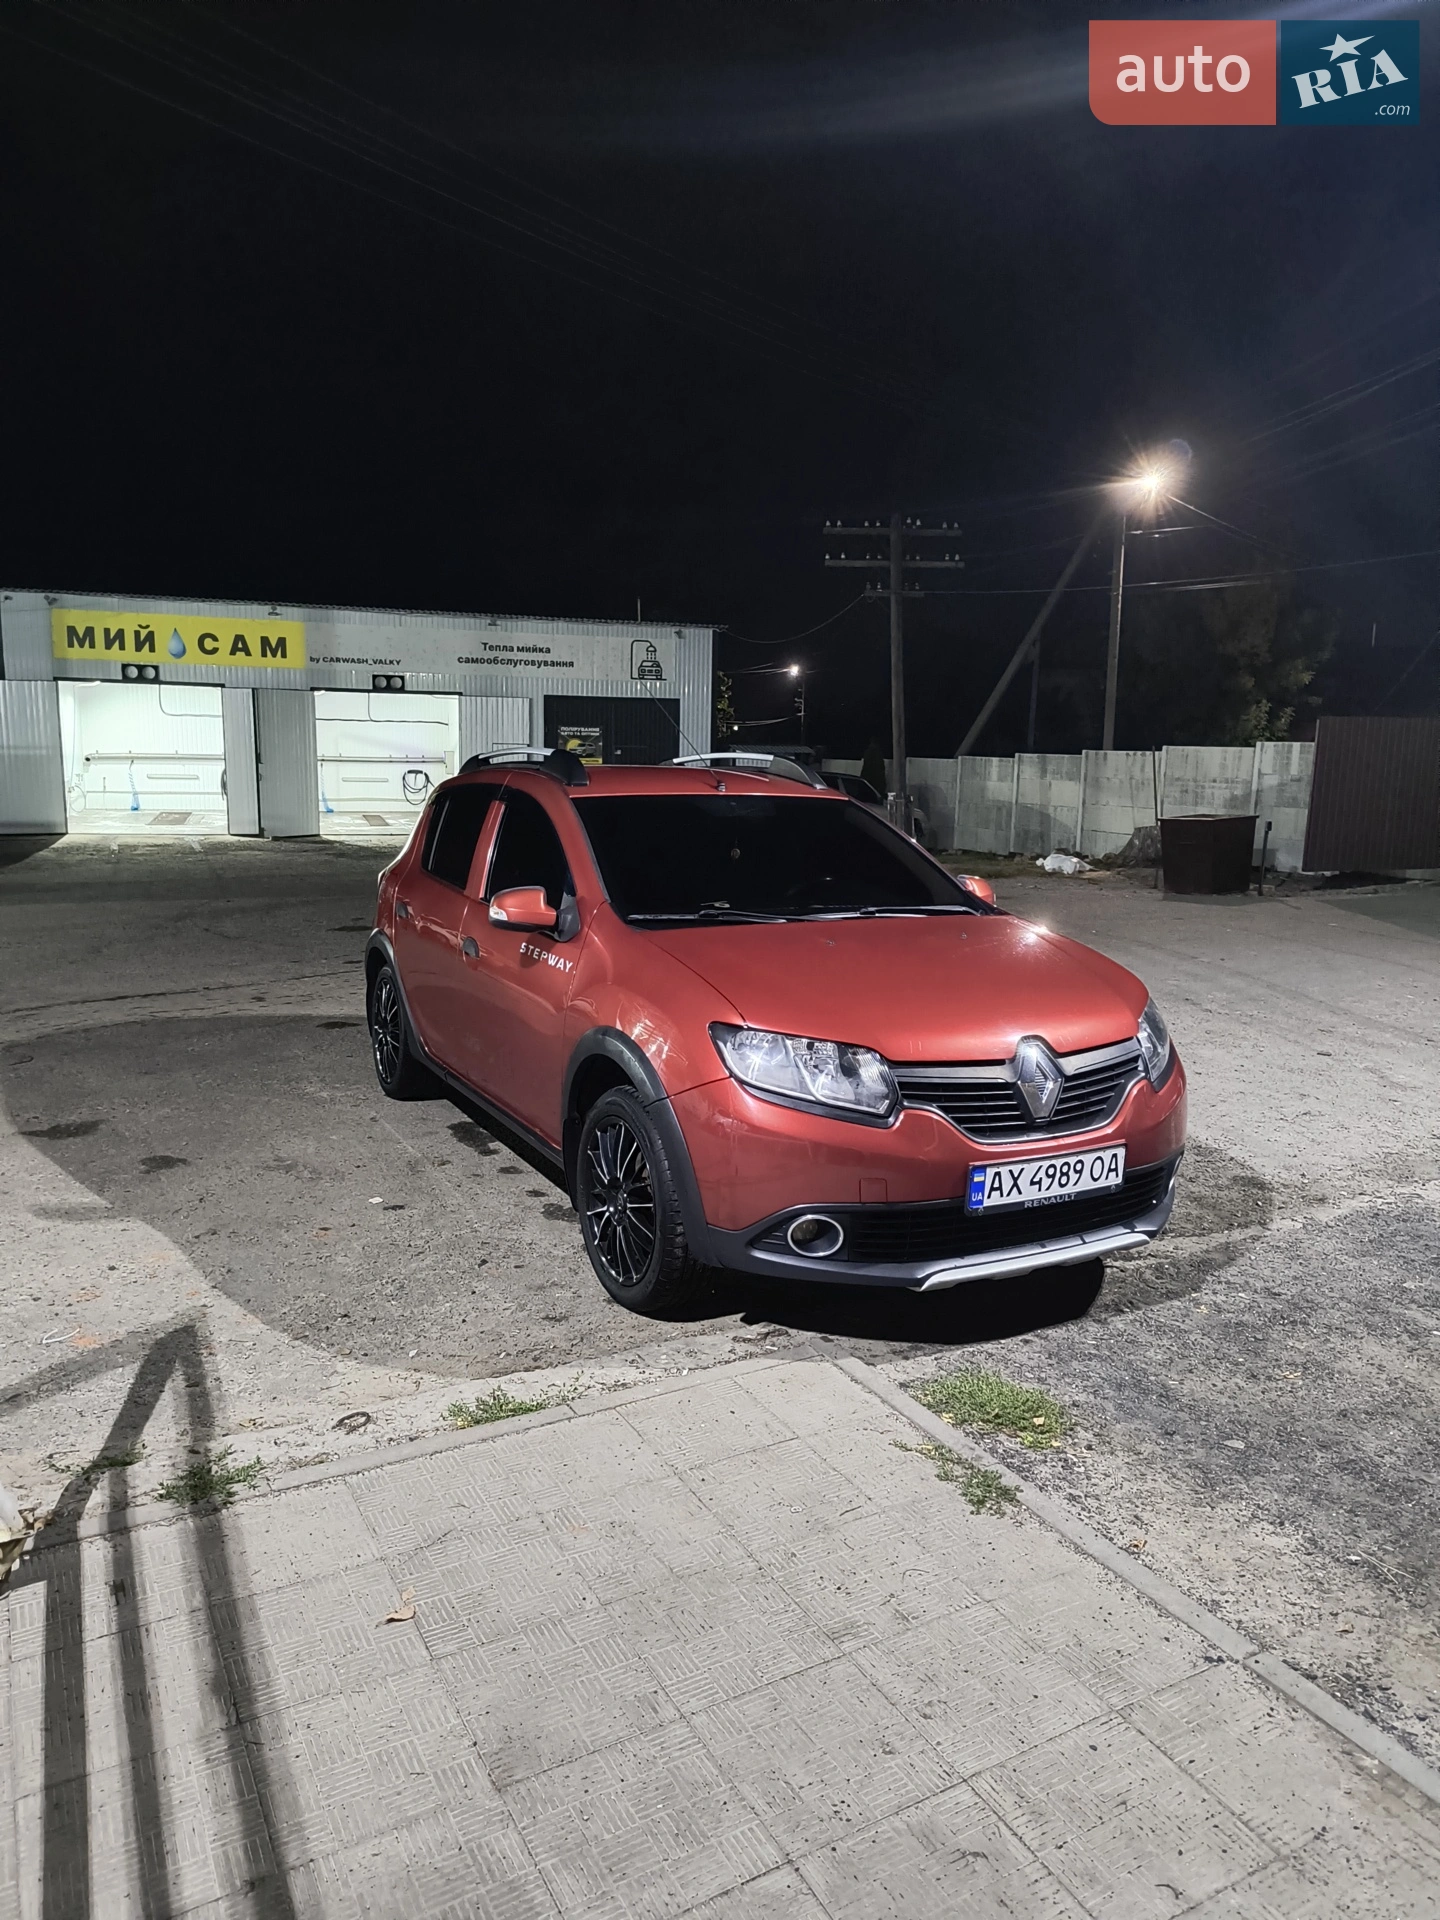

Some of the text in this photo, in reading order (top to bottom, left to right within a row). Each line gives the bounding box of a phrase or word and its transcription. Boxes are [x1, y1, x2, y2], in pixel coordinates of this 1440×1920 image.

[66, 624, 288, 659] МИЙ САМ
[481, 642, 552, 655] Тепла мийка
[309, 656, 402, 666] by CARWASH_VALKY
[457, 656, 575, 669] самообслуговування
[520, 942, 574, 973] STEPWAY
[986, 1152, 1119, 1199] AX 4989 OA
[971, 1192, 983, 1202] UA
[1024, 1193, 1077, 1208] RENAULT
